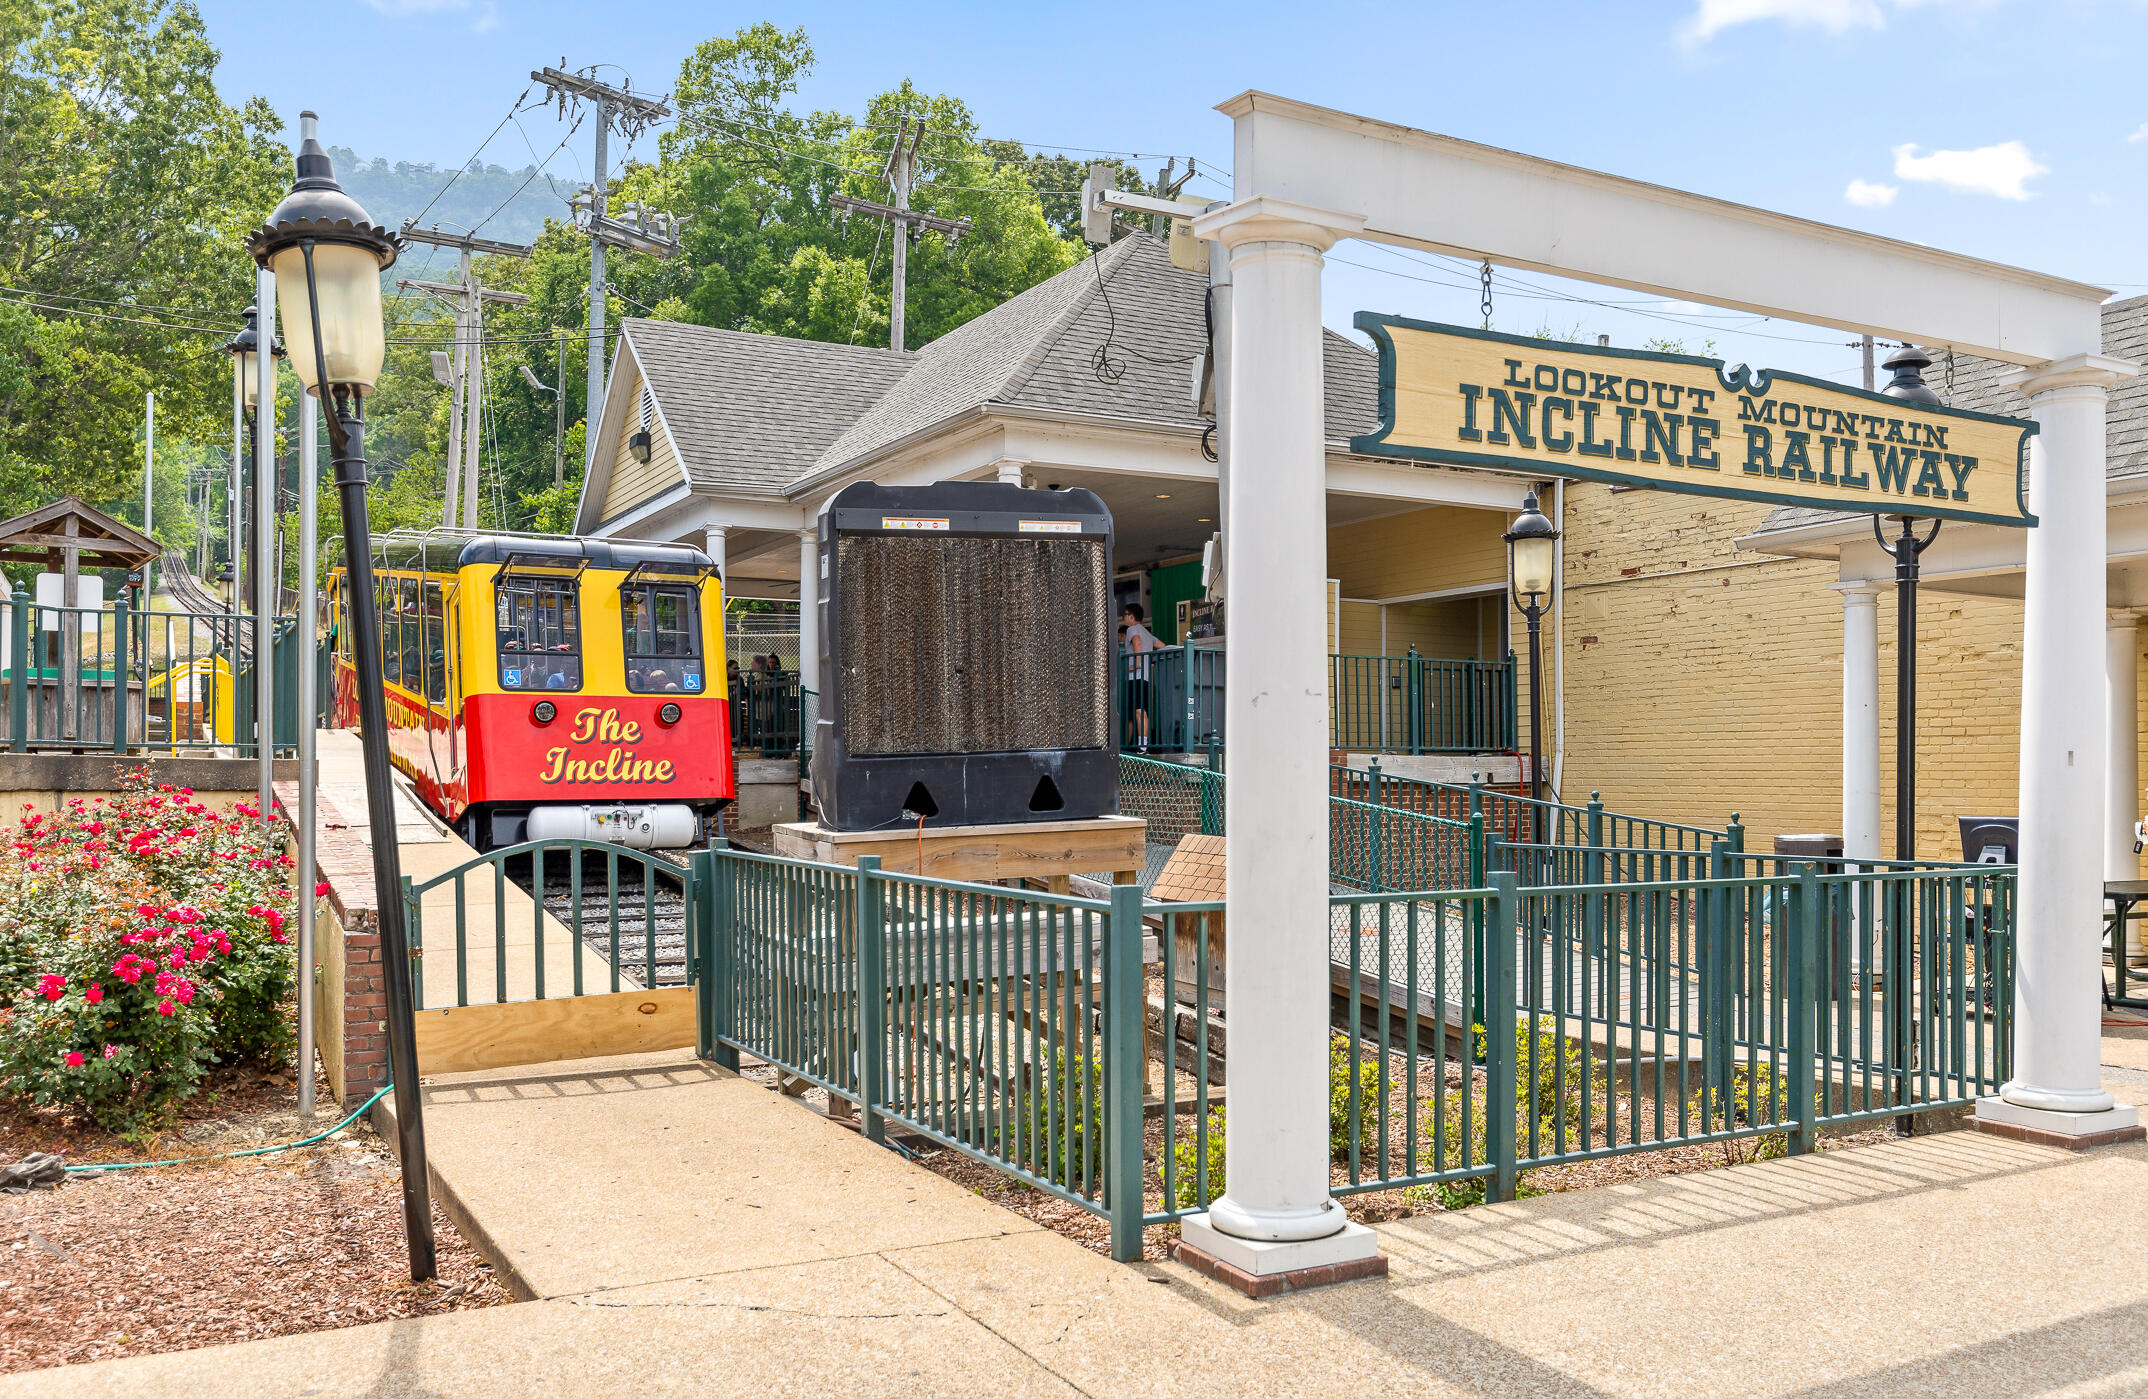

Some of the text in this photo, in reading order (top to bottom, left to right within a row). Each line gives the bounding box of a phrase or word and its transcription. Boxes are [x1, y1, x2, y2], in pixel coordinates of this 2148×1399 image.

[1504, 358, 1949, 450] LOOKOUT MOUNTAIN
[1458, 383, 1979, 502] INCLINE RAILWAY
[385, 697, 425, 740] OUNTAIN
[570, 707, 644, 745] The
[539, 746, 677, 785] Incline
